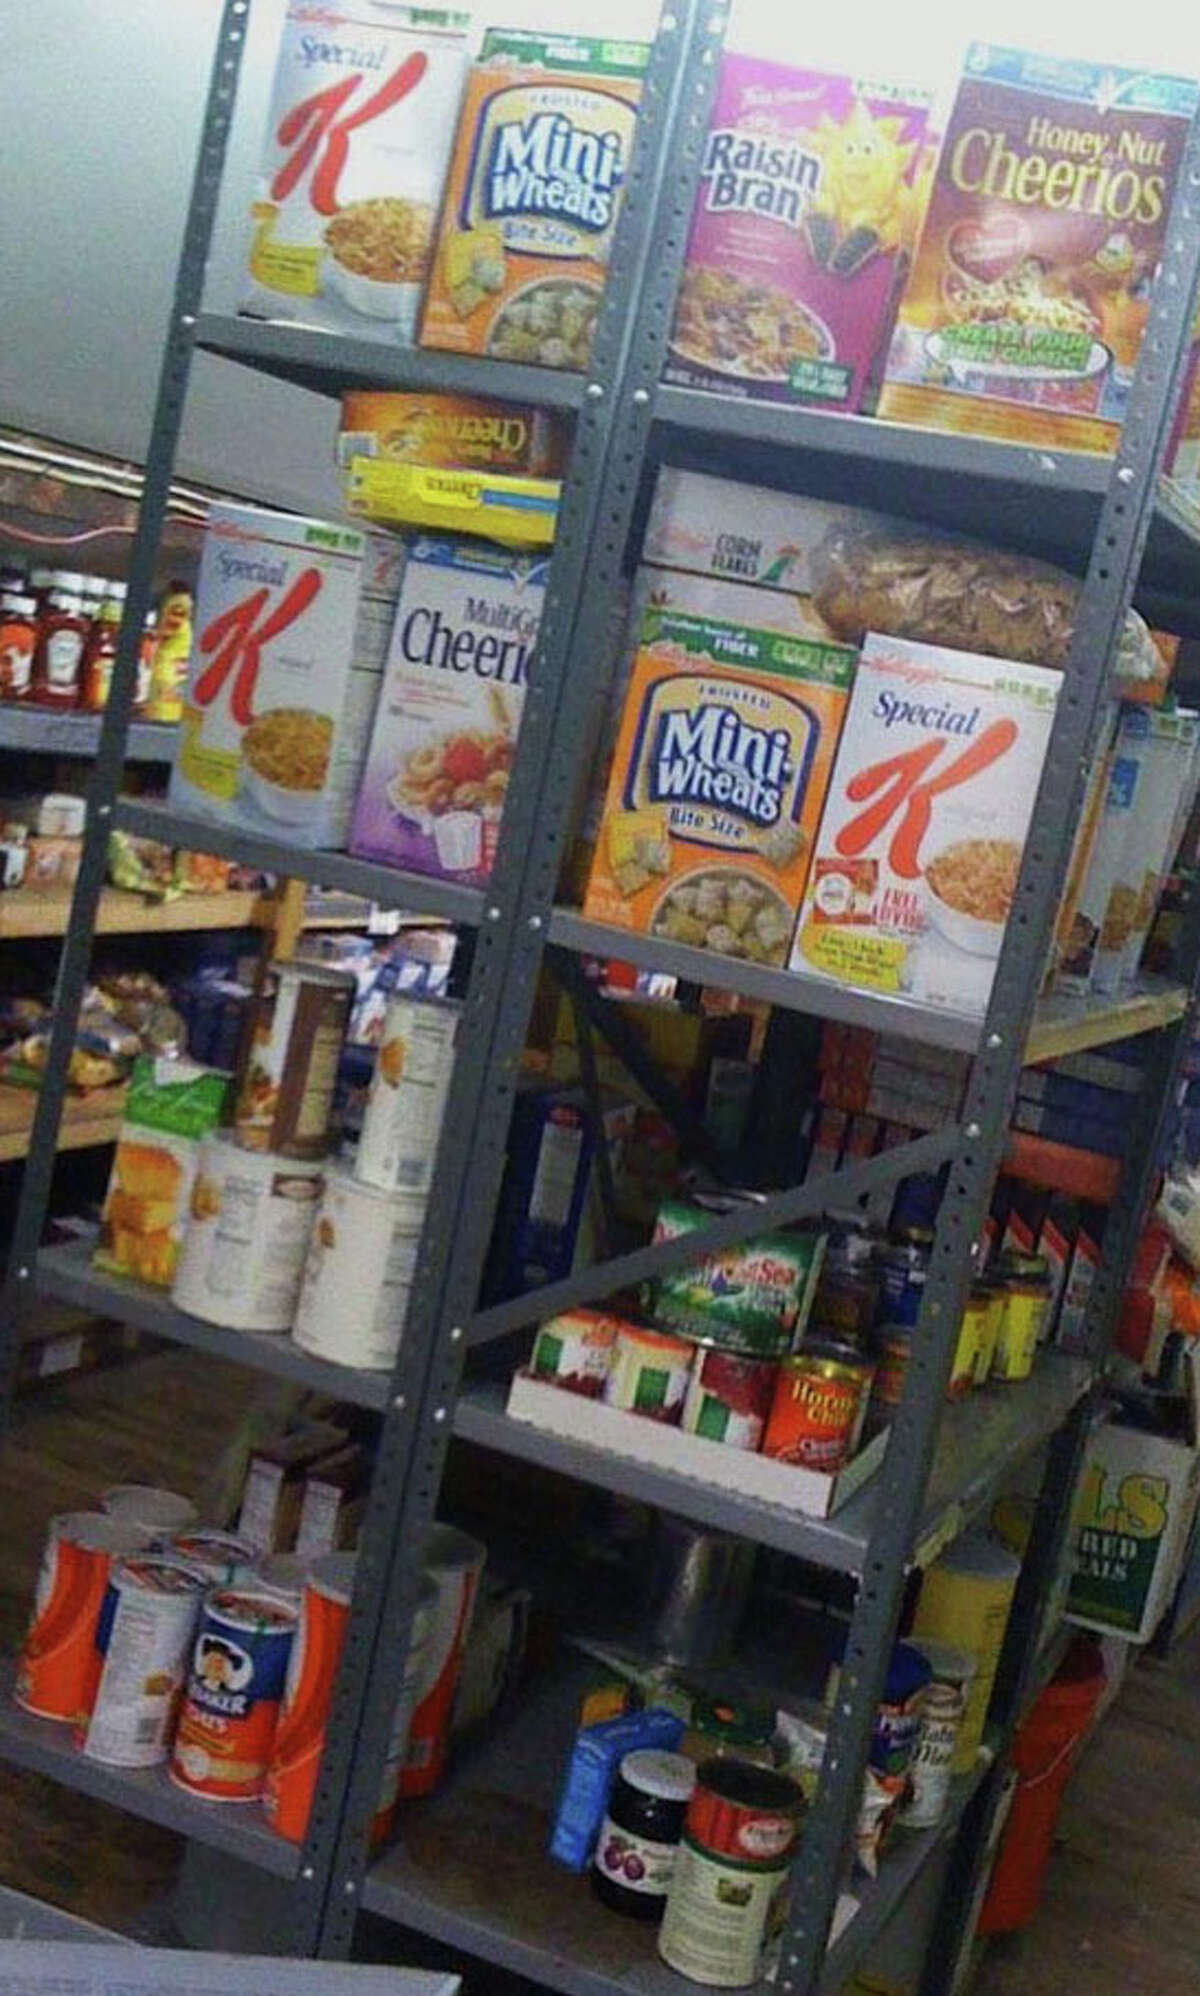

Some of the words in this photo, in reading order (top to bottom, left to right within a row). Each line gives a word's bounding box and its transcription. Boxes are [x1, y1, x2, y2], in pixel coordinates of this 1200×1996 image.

[297, 34, 389, 70] Special
[270, 51, 427, 216] K
[1026, 115, 1110, 164] Honey
[1117, 129, 1167, 167] Nut
[707, 132, 820, 192] Raisin
[951, 127, 1166, 225] Cheerios
[490, 170, 612, 227] Wheats
[711, 172, 801, 223] Bran
[216, 552, 290, 587] Special
[717, 533, 763, 556] CORN
[193, 567, 323, 726] K
[872, 690, 981, 736] Special
[654, 751, 781, 822] Wheats
[835, 717, 1019, 879] K
[669, 807, 705, 826] Bite
[710, 814, 748, 839] Size
